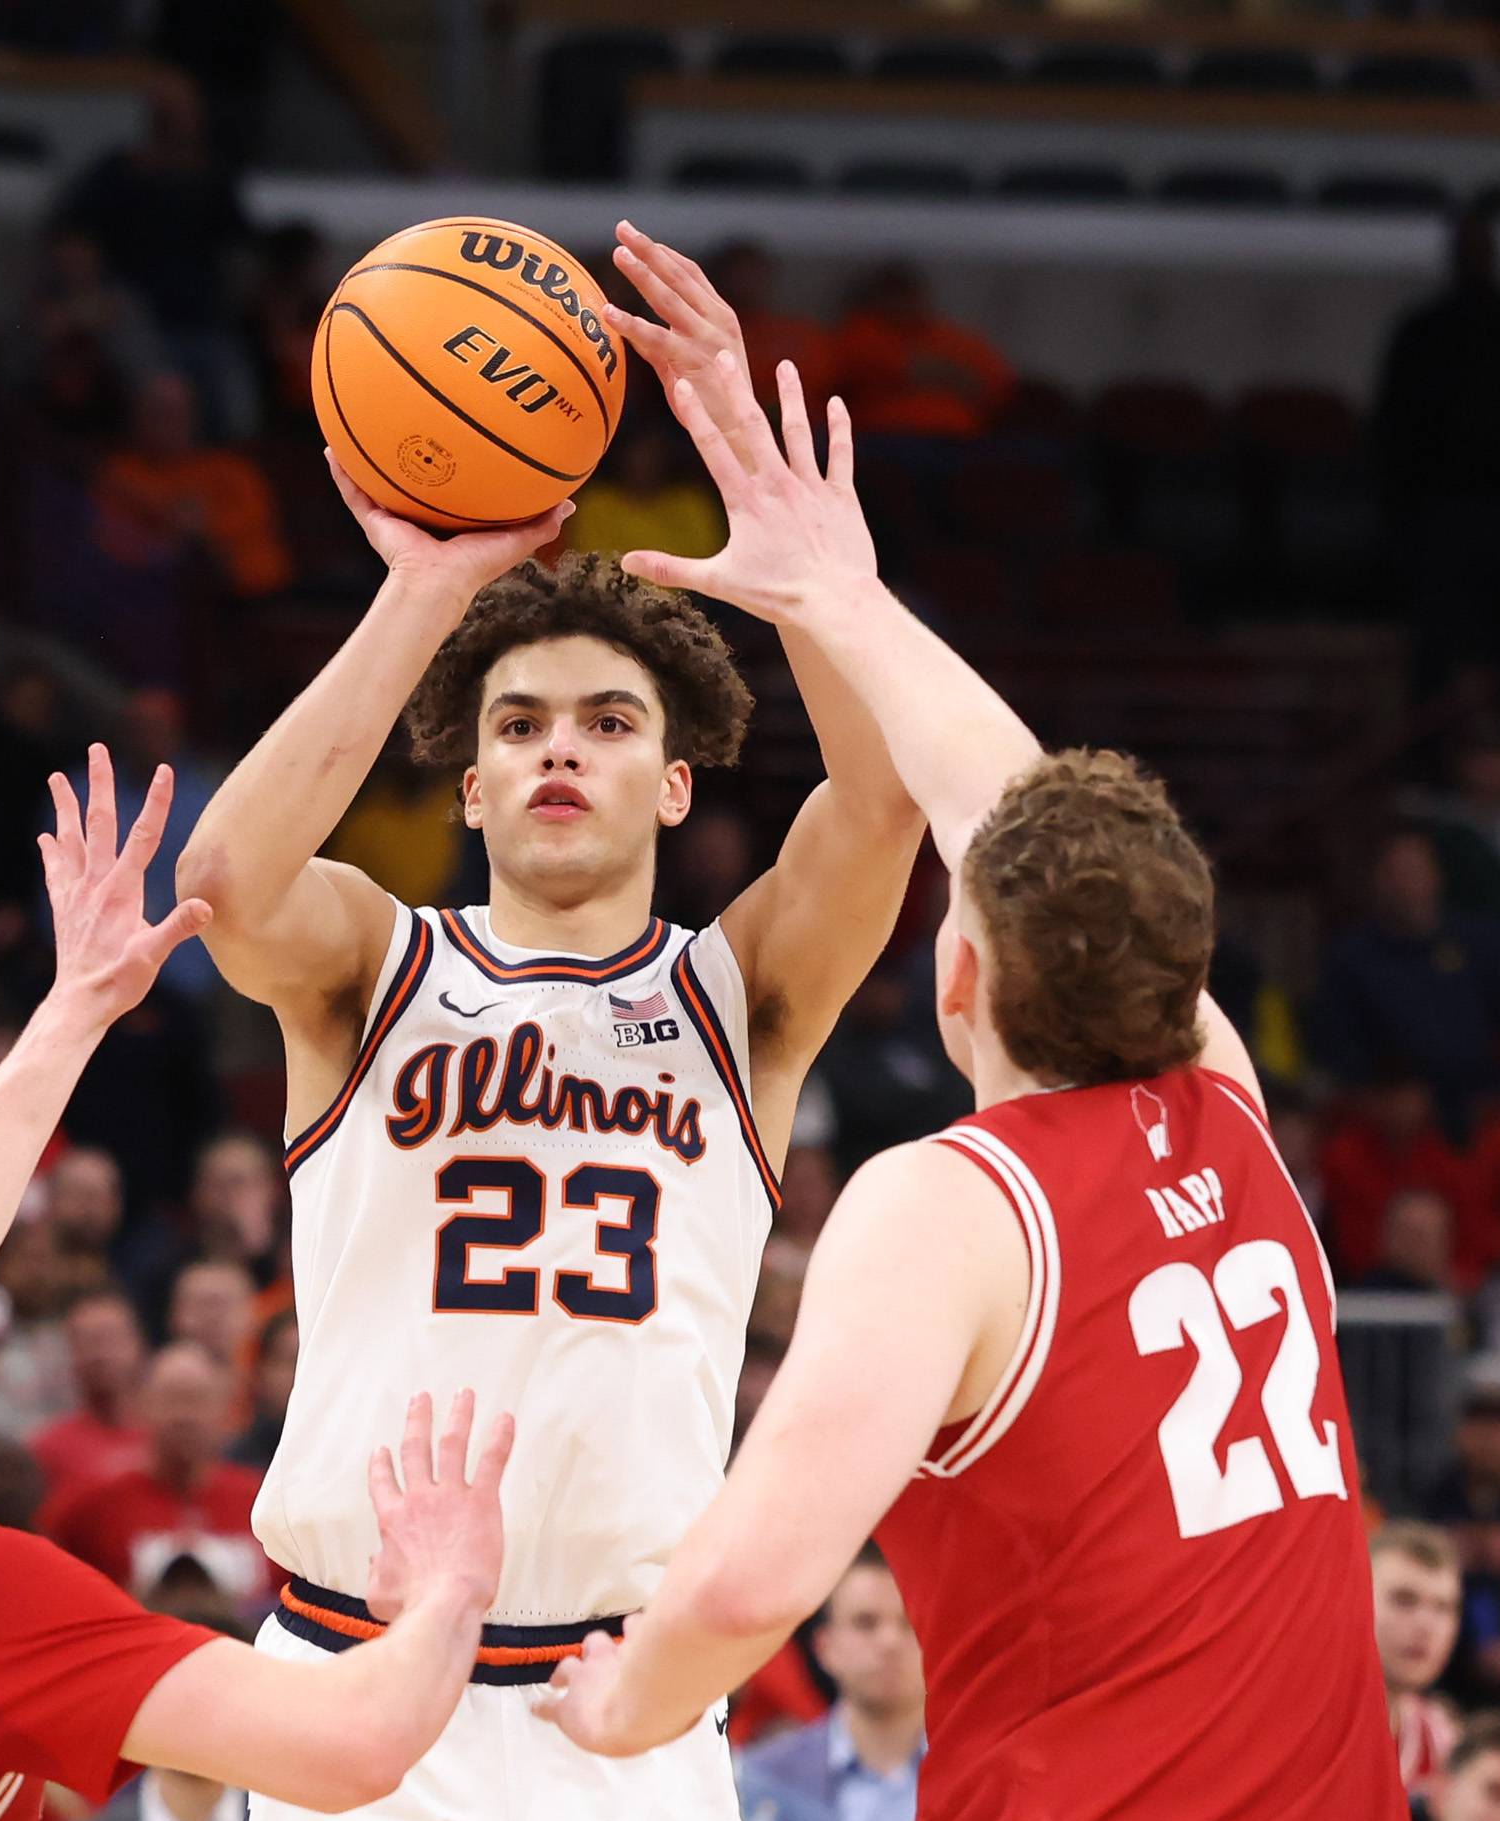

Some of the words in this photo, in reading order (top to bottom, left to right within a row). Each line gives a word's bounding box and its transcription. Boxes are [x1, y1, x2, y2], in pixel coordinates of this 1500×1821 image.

[442, 324, 558, 414] EVO
[554, 396, 584, 424] NXT
[461, 231, 617, 382] Wilson
[386, 1022, 706, 1166] Illinois
[432, 1156, 662, 1325] 23
[1144, 1167, 1226, 1239] RAPP
[1128, 1239, 1348, 1539] 22
